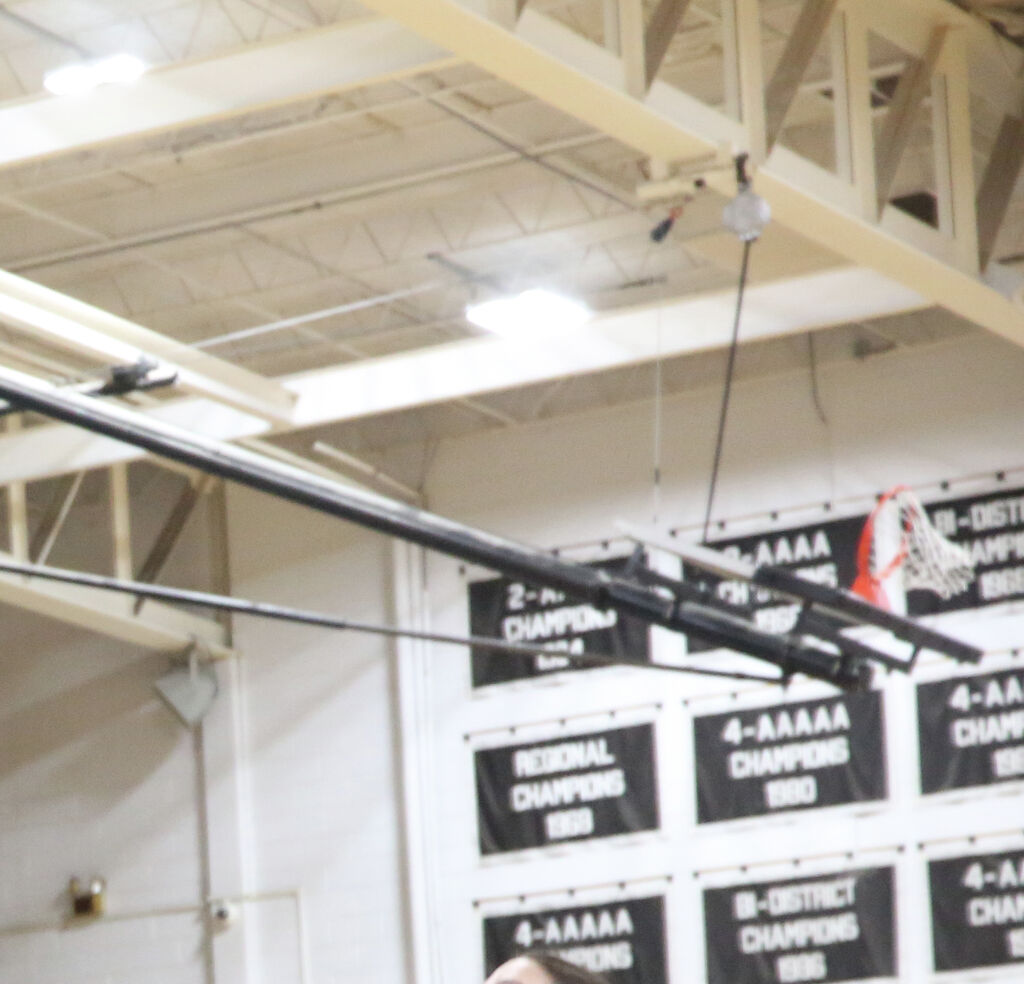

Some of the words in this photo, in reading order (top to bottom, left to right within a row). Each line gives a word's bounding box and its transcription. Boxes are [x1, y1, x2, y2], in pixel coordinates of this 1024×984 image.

[722, 702, 851, 745] 4-AAAAA
[514, 736, 616, 779] REGIONAL
[728, 736, 851, 780] CHAMPIONS
[511, 768, 626, 813] CHAMPIONS
[734, 876, 856, 921] BI-DISTRICT
[515, 907, 634, 947] 4-AAAAA
[739, 911, 860, 955] CHAMPIONS
